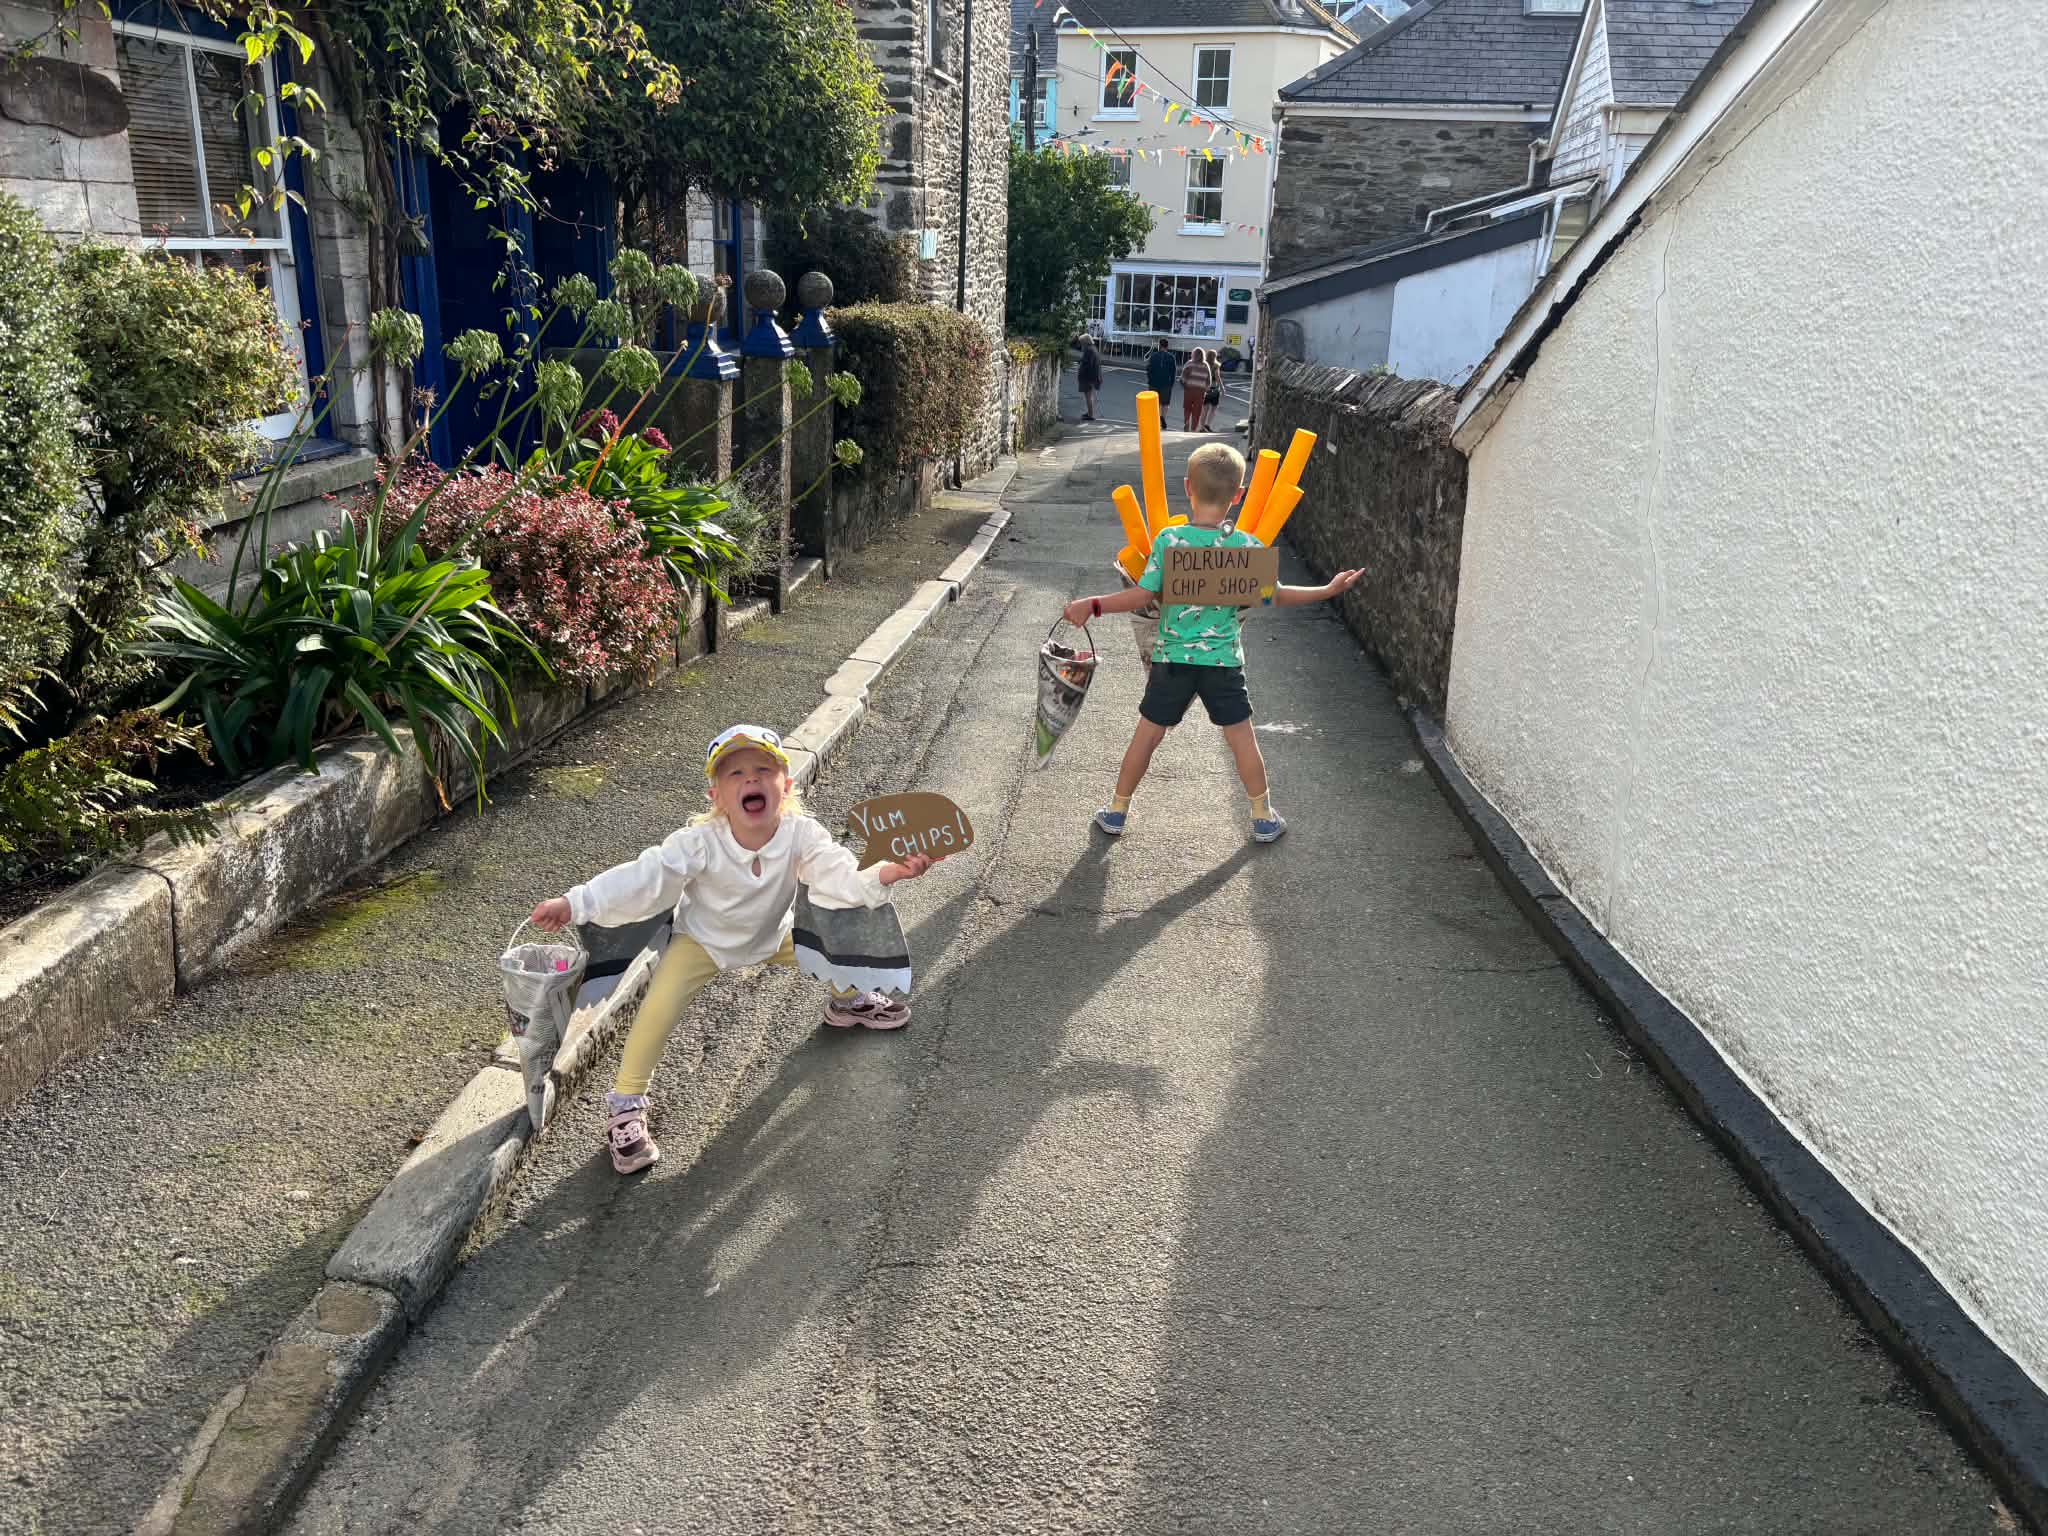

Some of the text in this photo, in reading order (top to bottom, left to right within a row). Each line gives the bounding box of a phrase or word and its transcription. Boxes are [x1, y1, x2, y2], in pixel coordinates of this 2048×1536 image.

[1172, 550, 1249, 572] POLRUAN
[1171, 577, 1259, 597] CHIP SHOP
